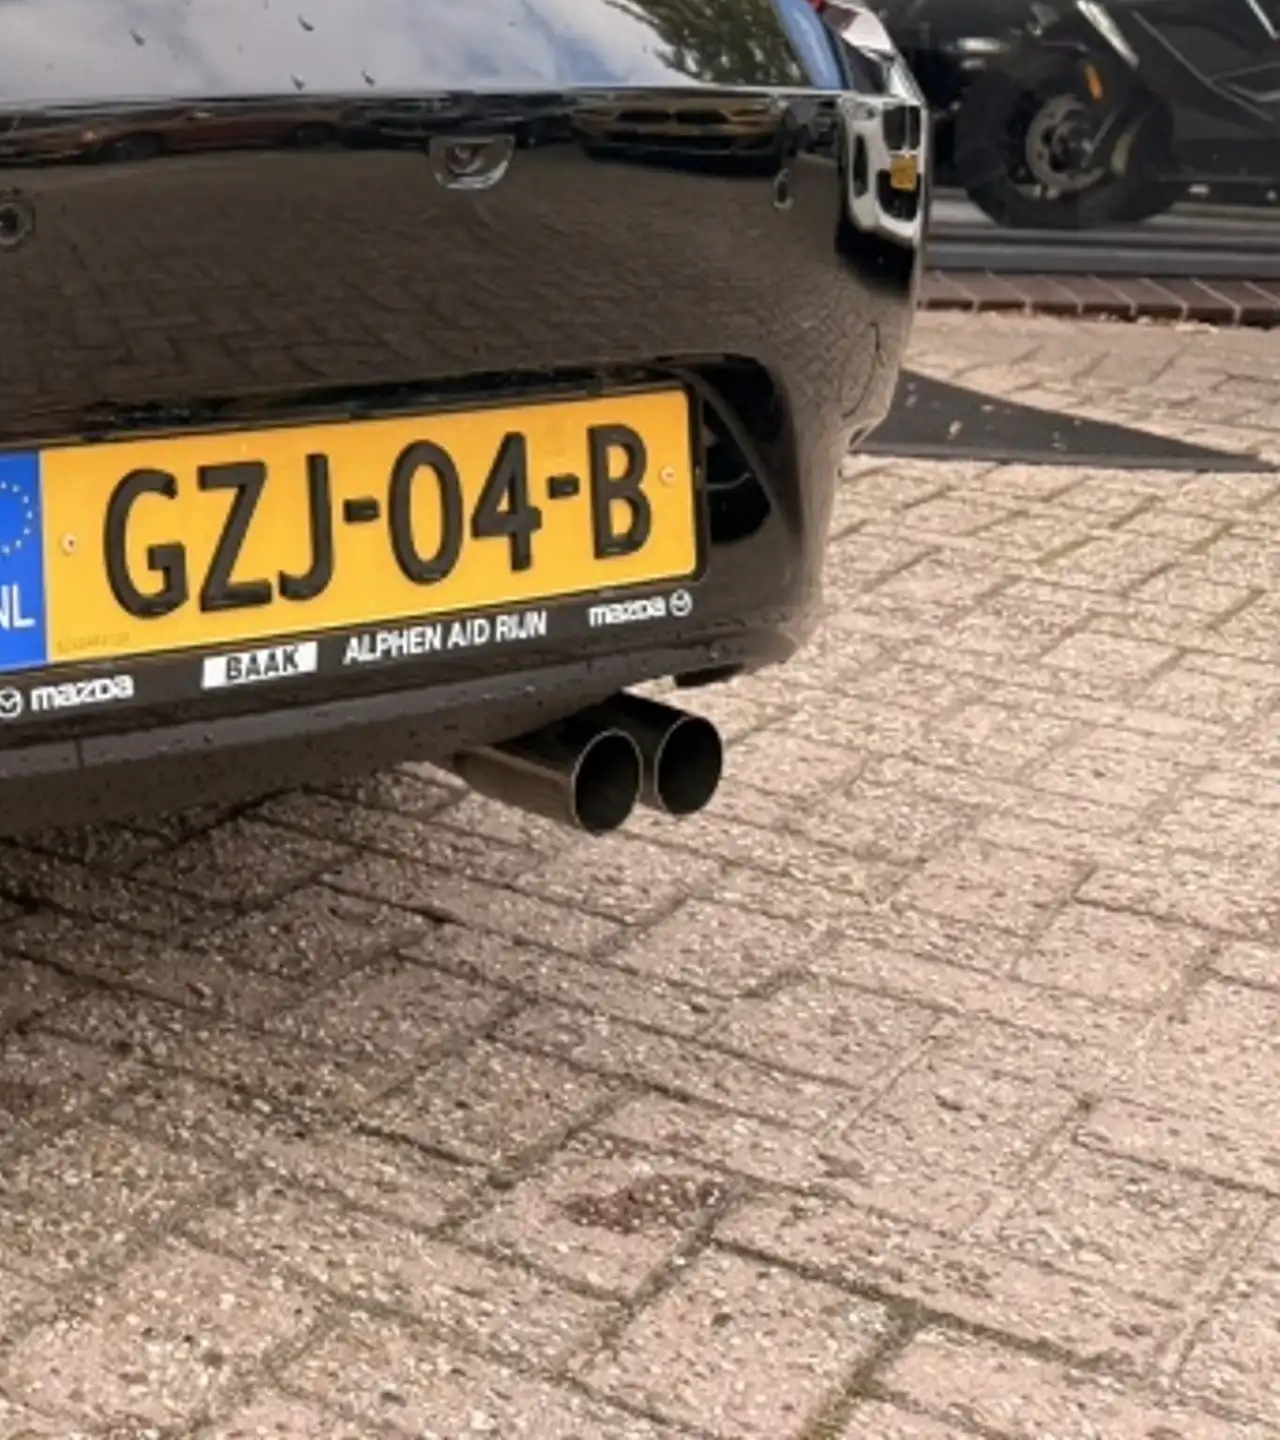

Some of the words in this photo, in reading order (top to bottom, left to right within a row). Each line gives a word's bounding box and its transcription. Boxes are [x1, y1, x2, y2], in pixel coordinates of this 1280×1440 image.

[101, 423, 653, 620] GZJ-04-B
[588, 594, 667, 628] mazda
[341, 623, 441, 665] ALPHEN
[495, 608, 548, 643] RIJN
[224, 644, 300, 682] BAAK
[30, 673, 136, 713] mazda
